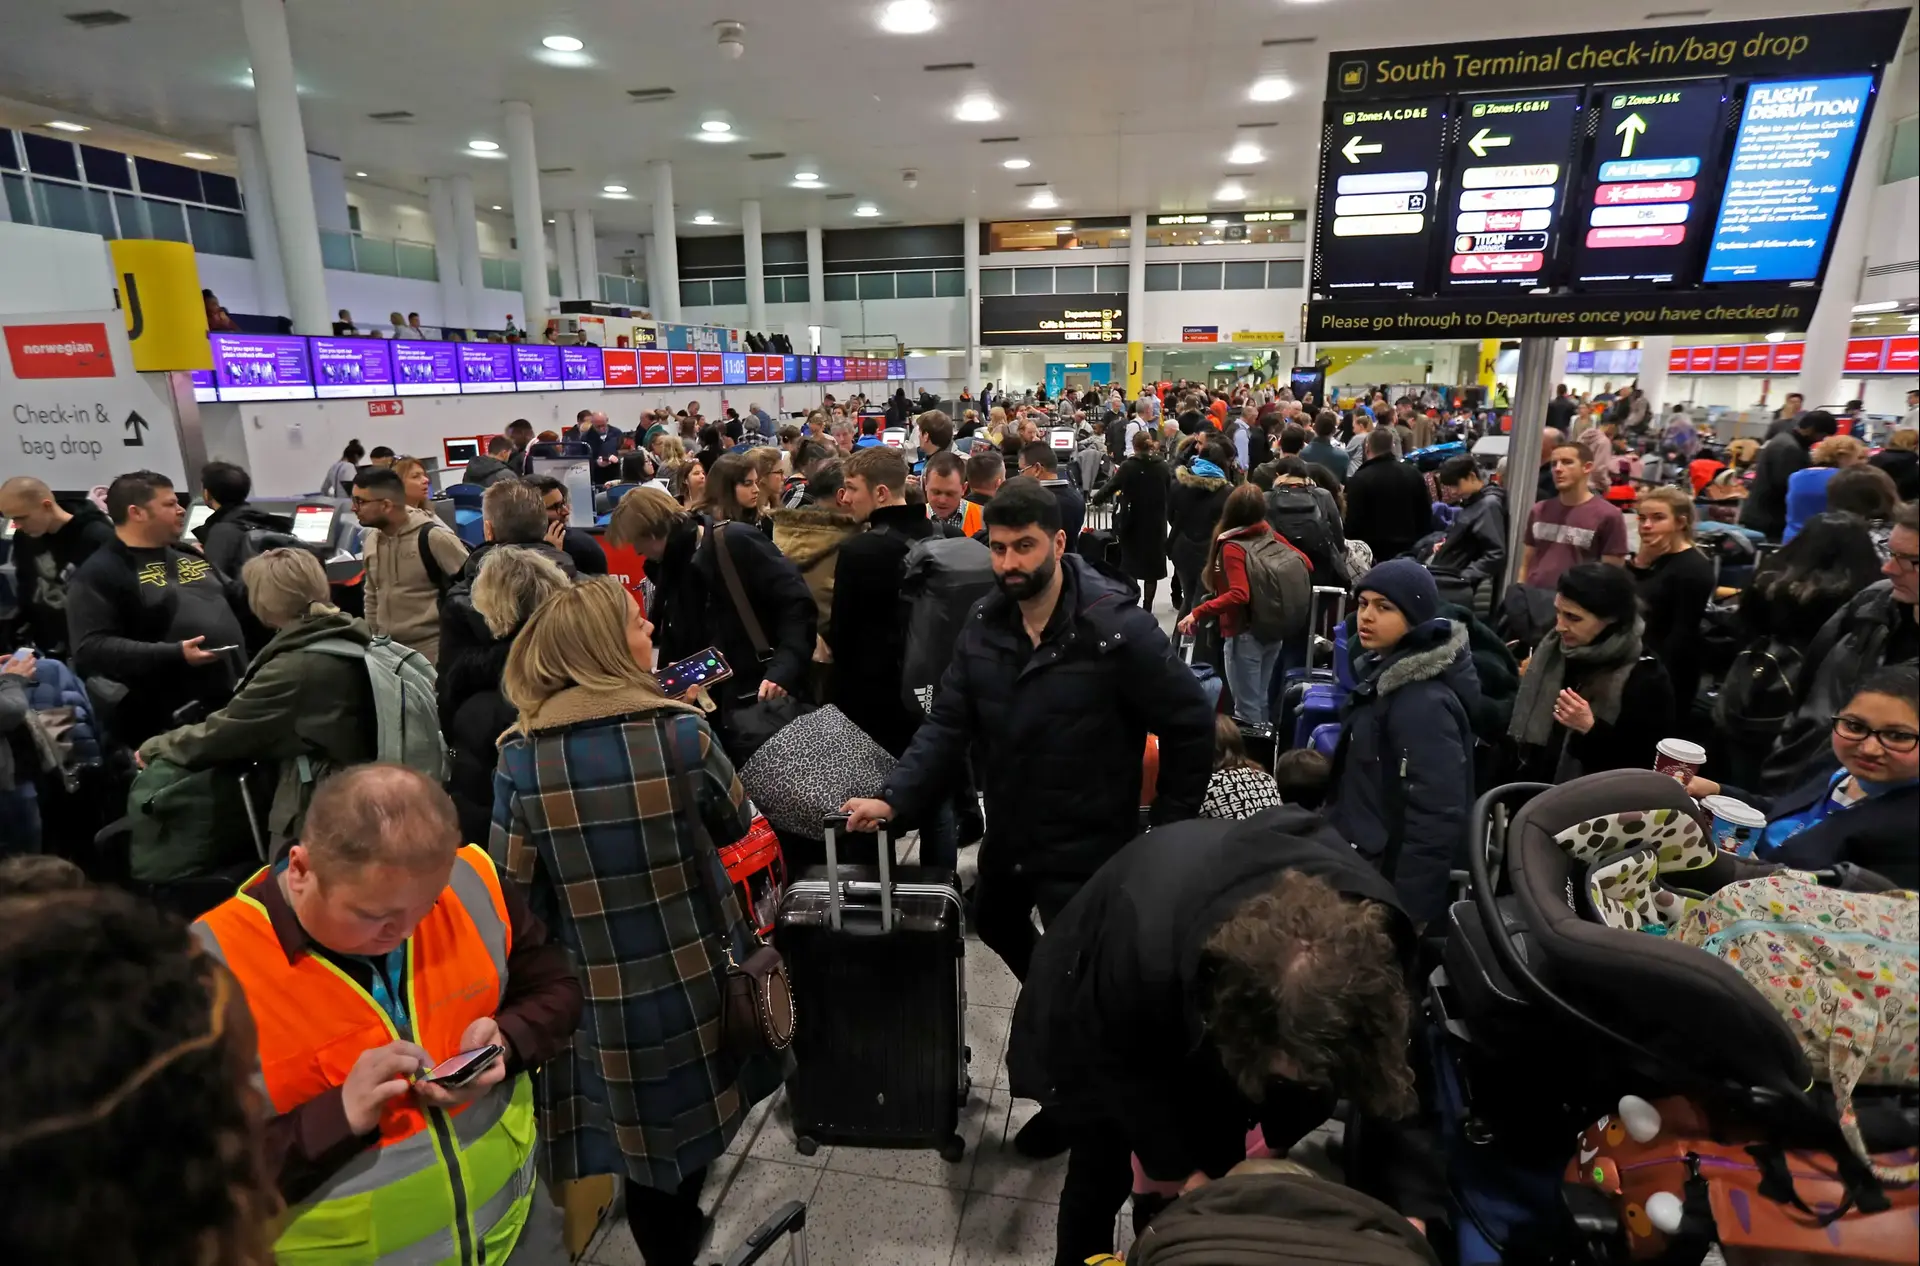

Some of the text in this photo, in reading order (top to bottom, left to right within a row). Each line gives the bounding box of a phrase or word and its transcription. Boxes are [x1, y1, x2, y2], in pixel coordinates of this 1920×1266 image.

[1376, 33, 1809, 84] South Terminal check-in/bag drop
[1627, 96, 1657, 106] Zones
[1663, 93, 1672, 103] &
[1672, 92, 1681, 103] K
[1752, 86, 1818, 105] FLIGHT
[1486, 104, 1515, 114] Zones
[1523, 102, 1531, 112] G
[1531, 101, 1540, 111] &
[1540, 100, 1549, 111] H
[1748, 98, 1859, 120] DISRUPTION
[1357, 112, 1383, 122] Zones
[1421, 108, 1428, 118] E
[1475, 234, 1507, 245] TITAN
[124, 273, 144, 341] J
[1321, 304, 1799, 332] Please go through to Departures once you have checked in
[23, 341, 94, 356] norwegian
[725, 360, 744, 374] 11:05
[1130, 361, 1137, 375] J
[1485, 358, 1496, 373] K
[13, 403, 111, 425] Check-in &
[370, 404, 387, 413] Exit
[20, 435, 104, 461] bag drop
[925, 684, 933, 714] adidas
